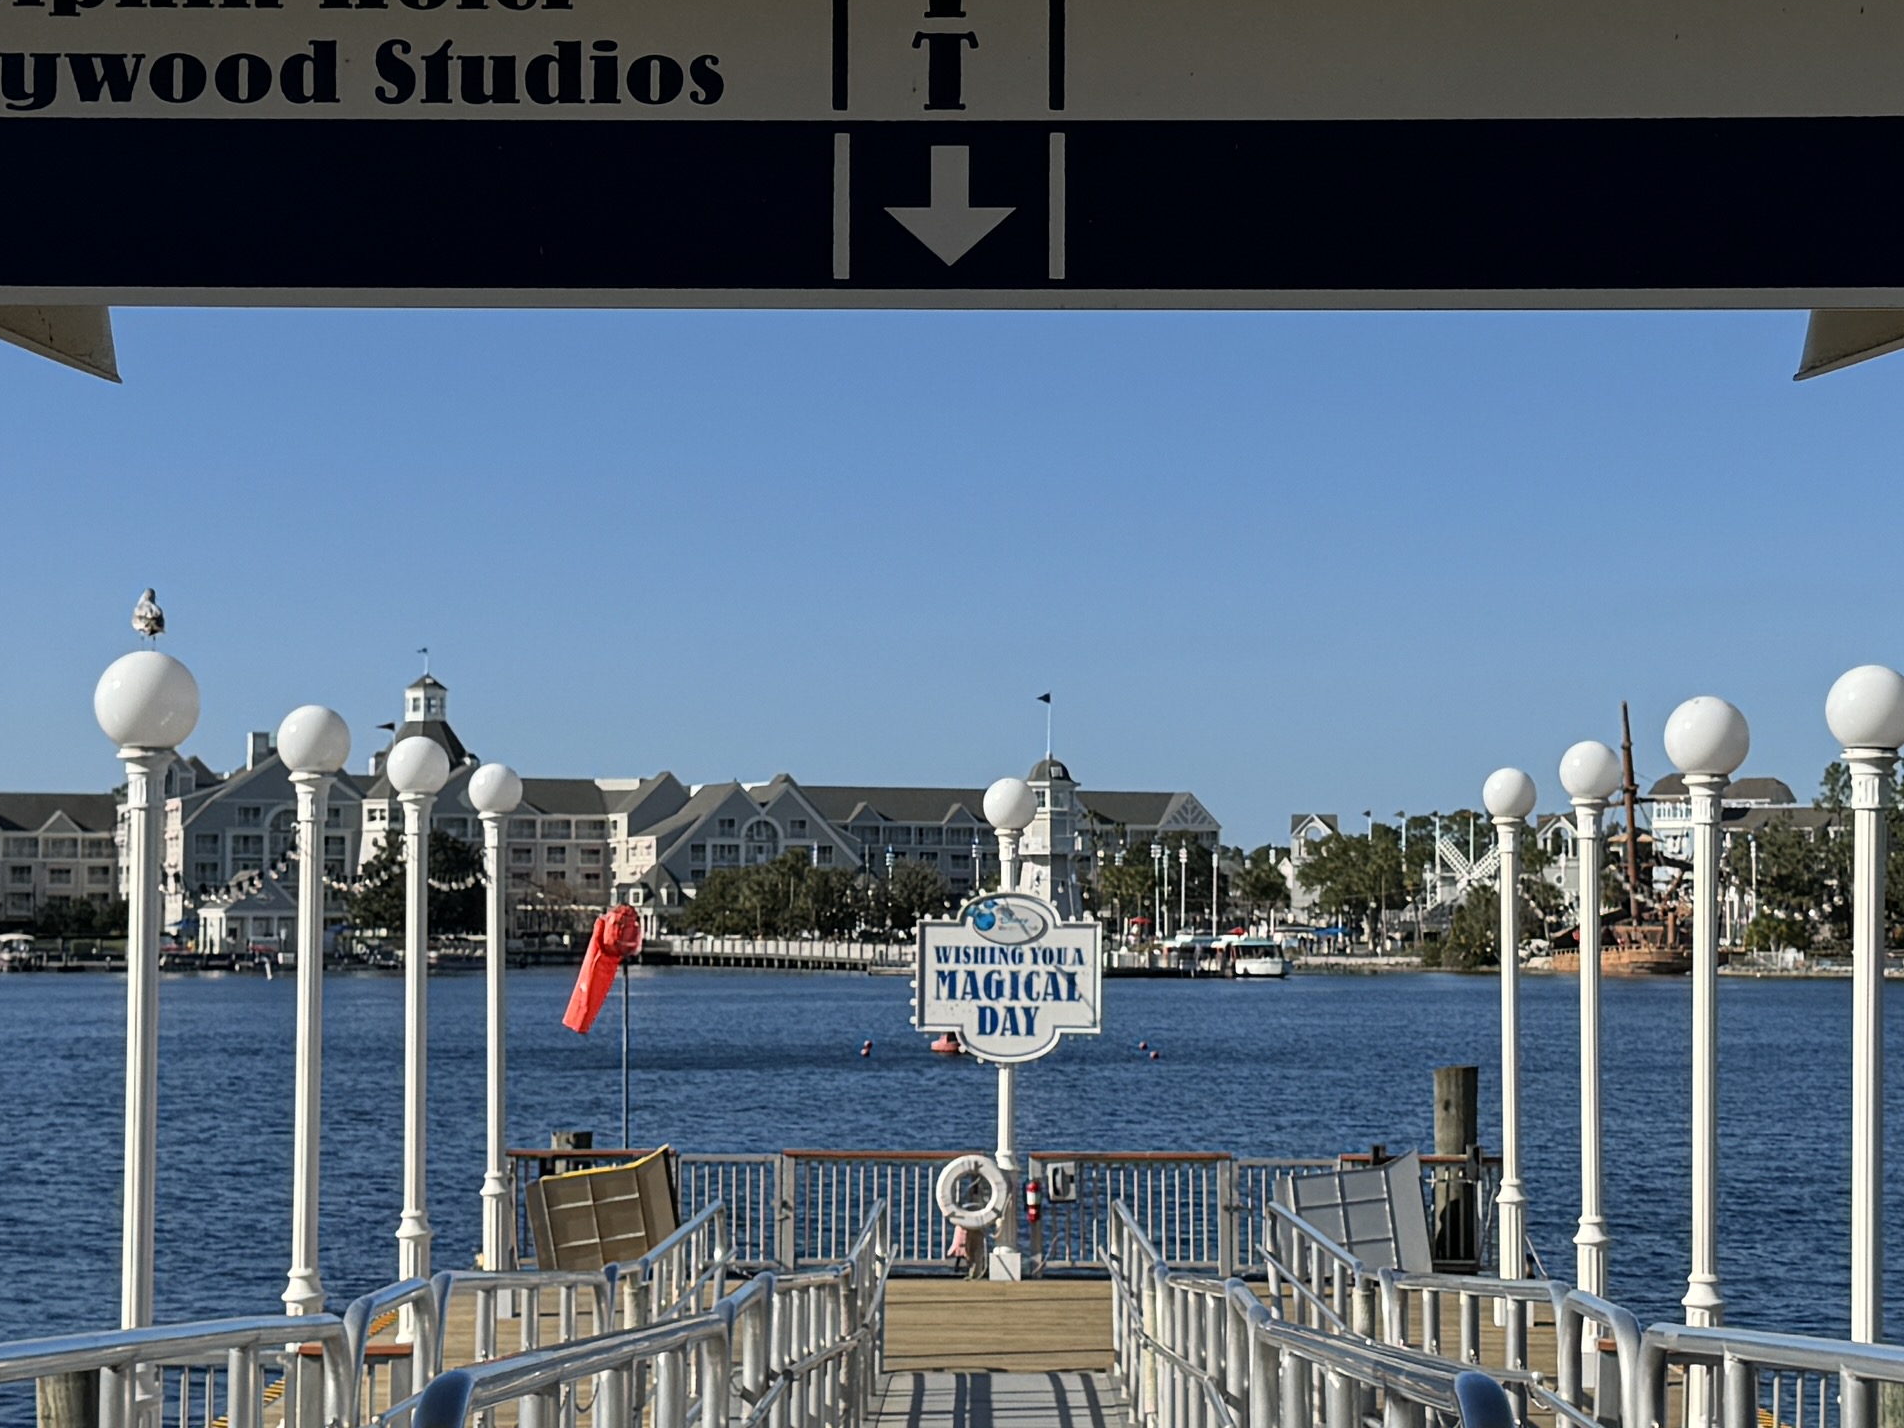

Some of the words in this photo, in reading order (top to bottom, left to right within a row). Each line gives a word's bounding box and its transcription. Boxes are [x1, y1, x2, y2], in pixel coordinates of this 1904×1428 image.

[375, 39, 724, 105] Studios
[935, 947, 1024, 965] WISHING
[1030, 947, 1067, 965] YOU
[1071, 948, 1085, 965] A
[936, 970, 1082, 1002] MAGICAL
[977, 1006, 1040, 1036] DAY
